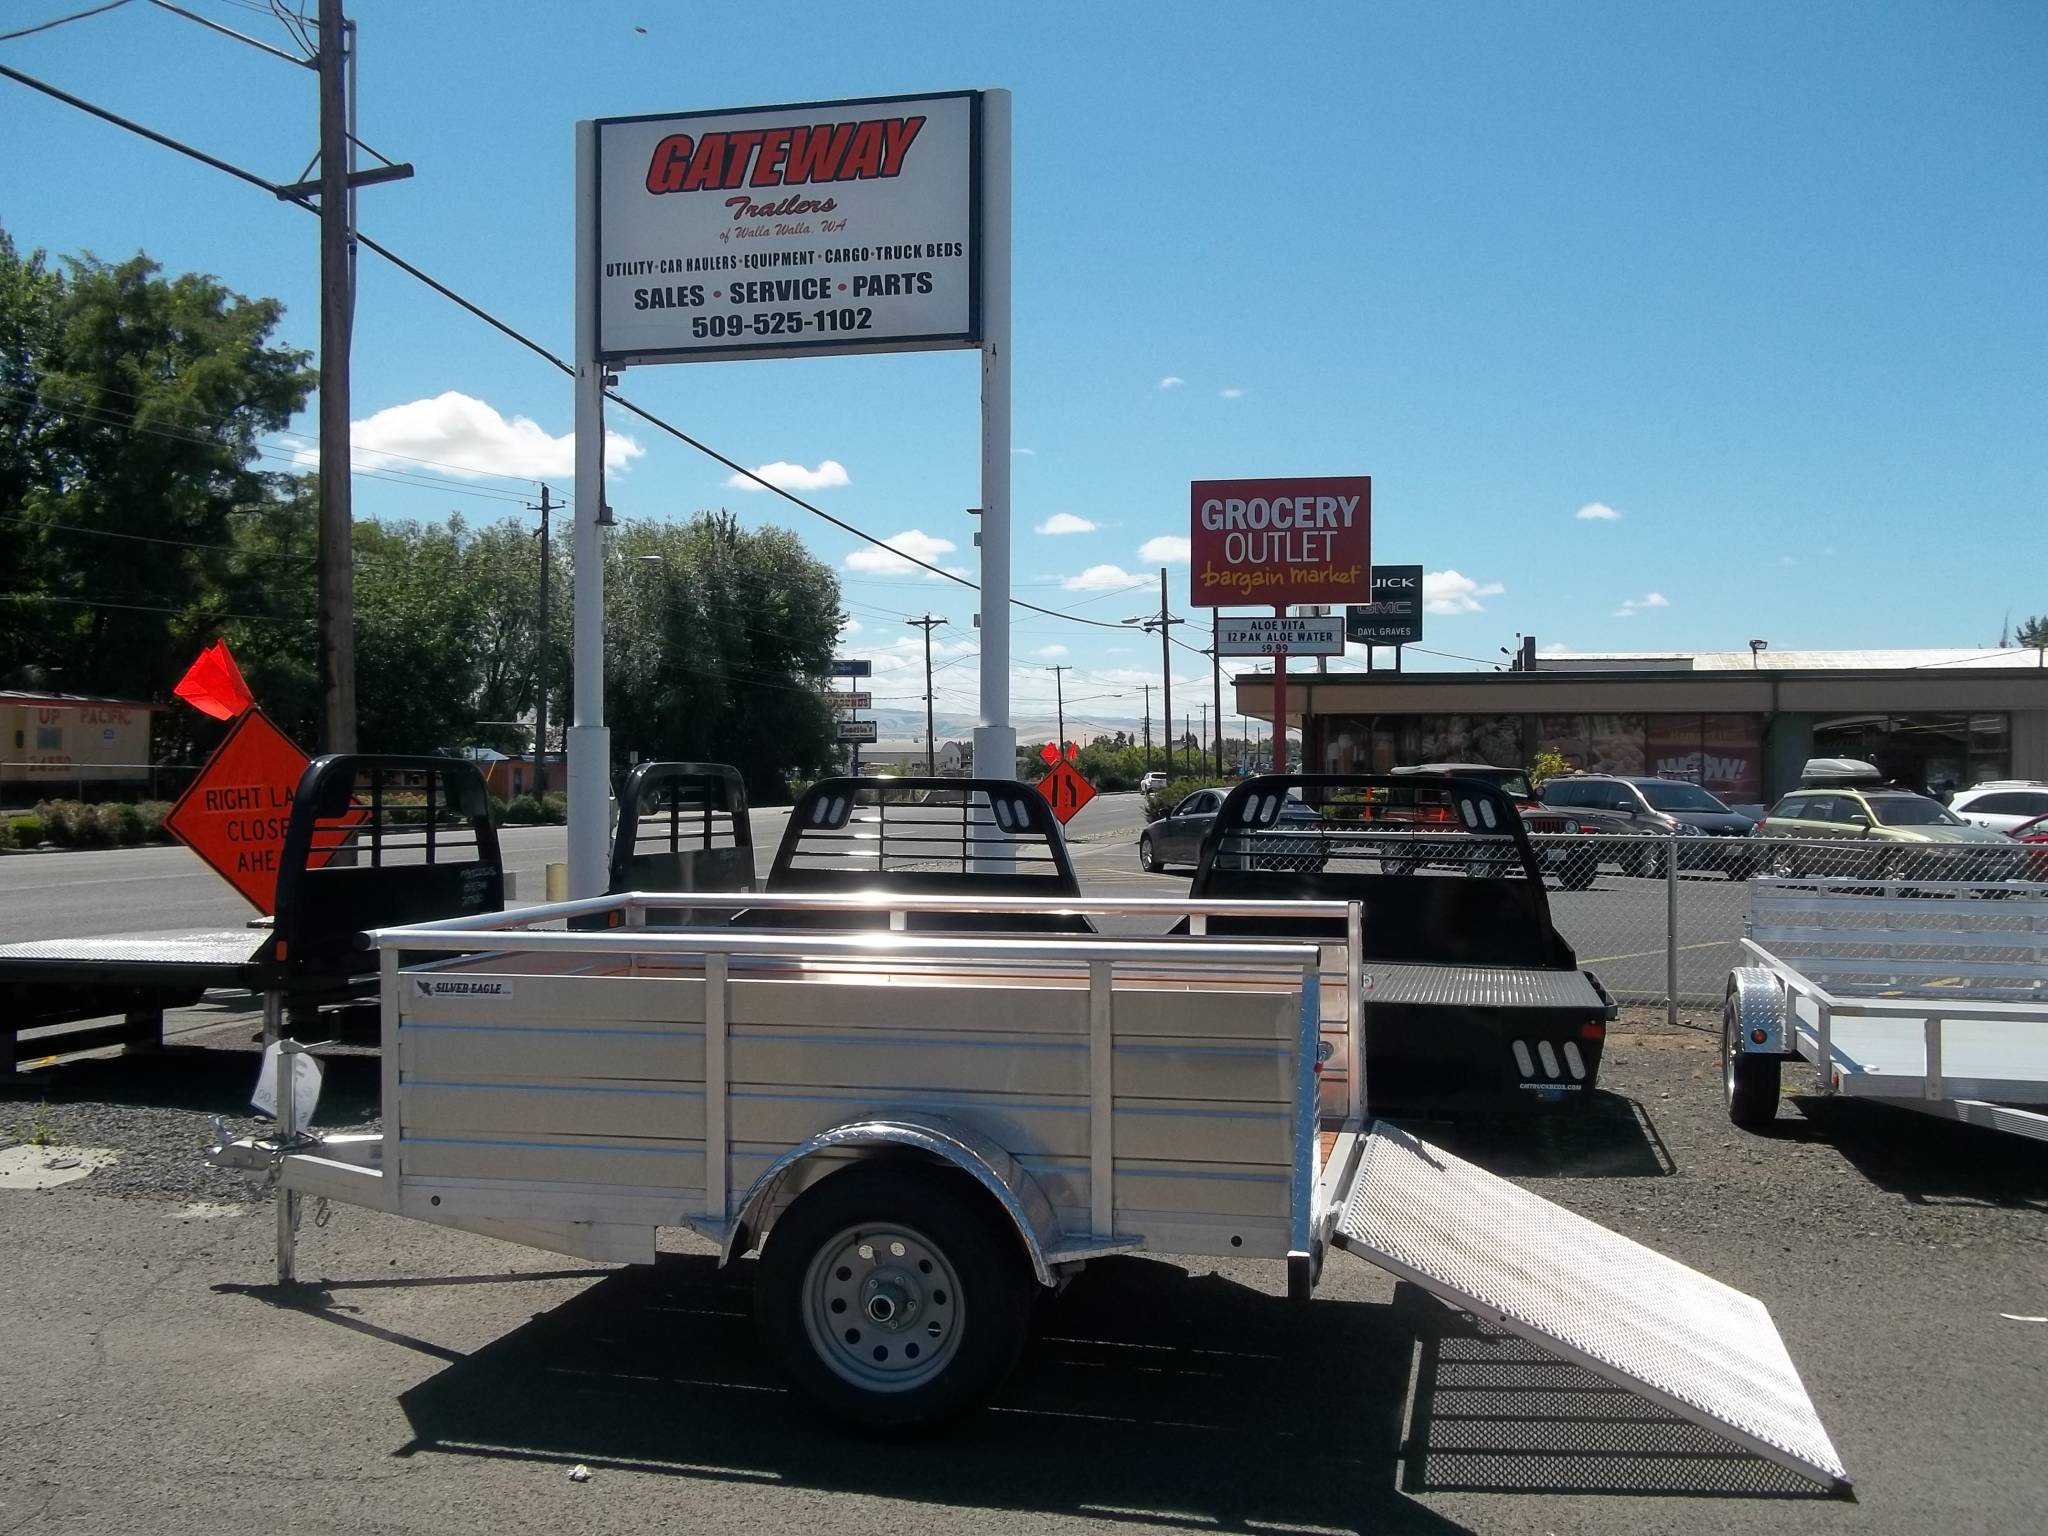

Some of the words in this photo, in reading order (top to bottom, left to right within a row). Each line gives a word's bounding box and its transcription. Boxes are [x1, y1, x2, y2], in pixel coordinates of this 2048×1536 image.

[645, 115, 927, 196] GATEWAY
[725, 194, 837, 220] Trailers
[719, 228, 731, 244] of
[735, 224, 770, 239] Walla
[774, 220, 814, 236] Walla,
[820, 217, 848, 233] WA
[606, 260, 653, 277] UTILITY
[660, 258, 682, 274] CAR
[686, 255, 737, 272] HAULERS
[744, 250, 815, 269] EQUIPMENT
[825, 247, 869, 264] CARGO
[876, 244, 922, 261] TRUCK
[926, 242, 963, 258] BEDS
[634, 284, 705, 310] SALES
[729, 277, 831, 304] SERVICE
[853, 271, 933, 298] PARTS
[692, 307, 872, 339] 509-525-1102
[1201, 495, 1360, 531] GROCERY
[1225, 530, 1338, 564] OUTLET
[1200, 560, 1284, 595] bargain
[1290, 565, 1361, 585] market
[1372, 578, 1415, 588] UICK
[1357, 602, 1411, 614] GMC
[1250, 621, 1277, 630] ALOE
[1281, 621, 1305, 630] VITA
[1267, 632, 1293, 641] ALOE
[1298, 632, 1333, 641] WATER
[1358, 627, 1376, 636] DAYL
[1380, 627, 1411, 636] GRAVES
[1261, 643, 1288, 653] $9.99
[206, 787, 261, 811] RIGHT
[270, 786, 295, 808] LA
[227, 817, 291, 841] CLOSE
[238, 850, 277, 872] AHE
[435, 983, 469, 993] SILVER
[470, 983, 502, 993] EAGLE
